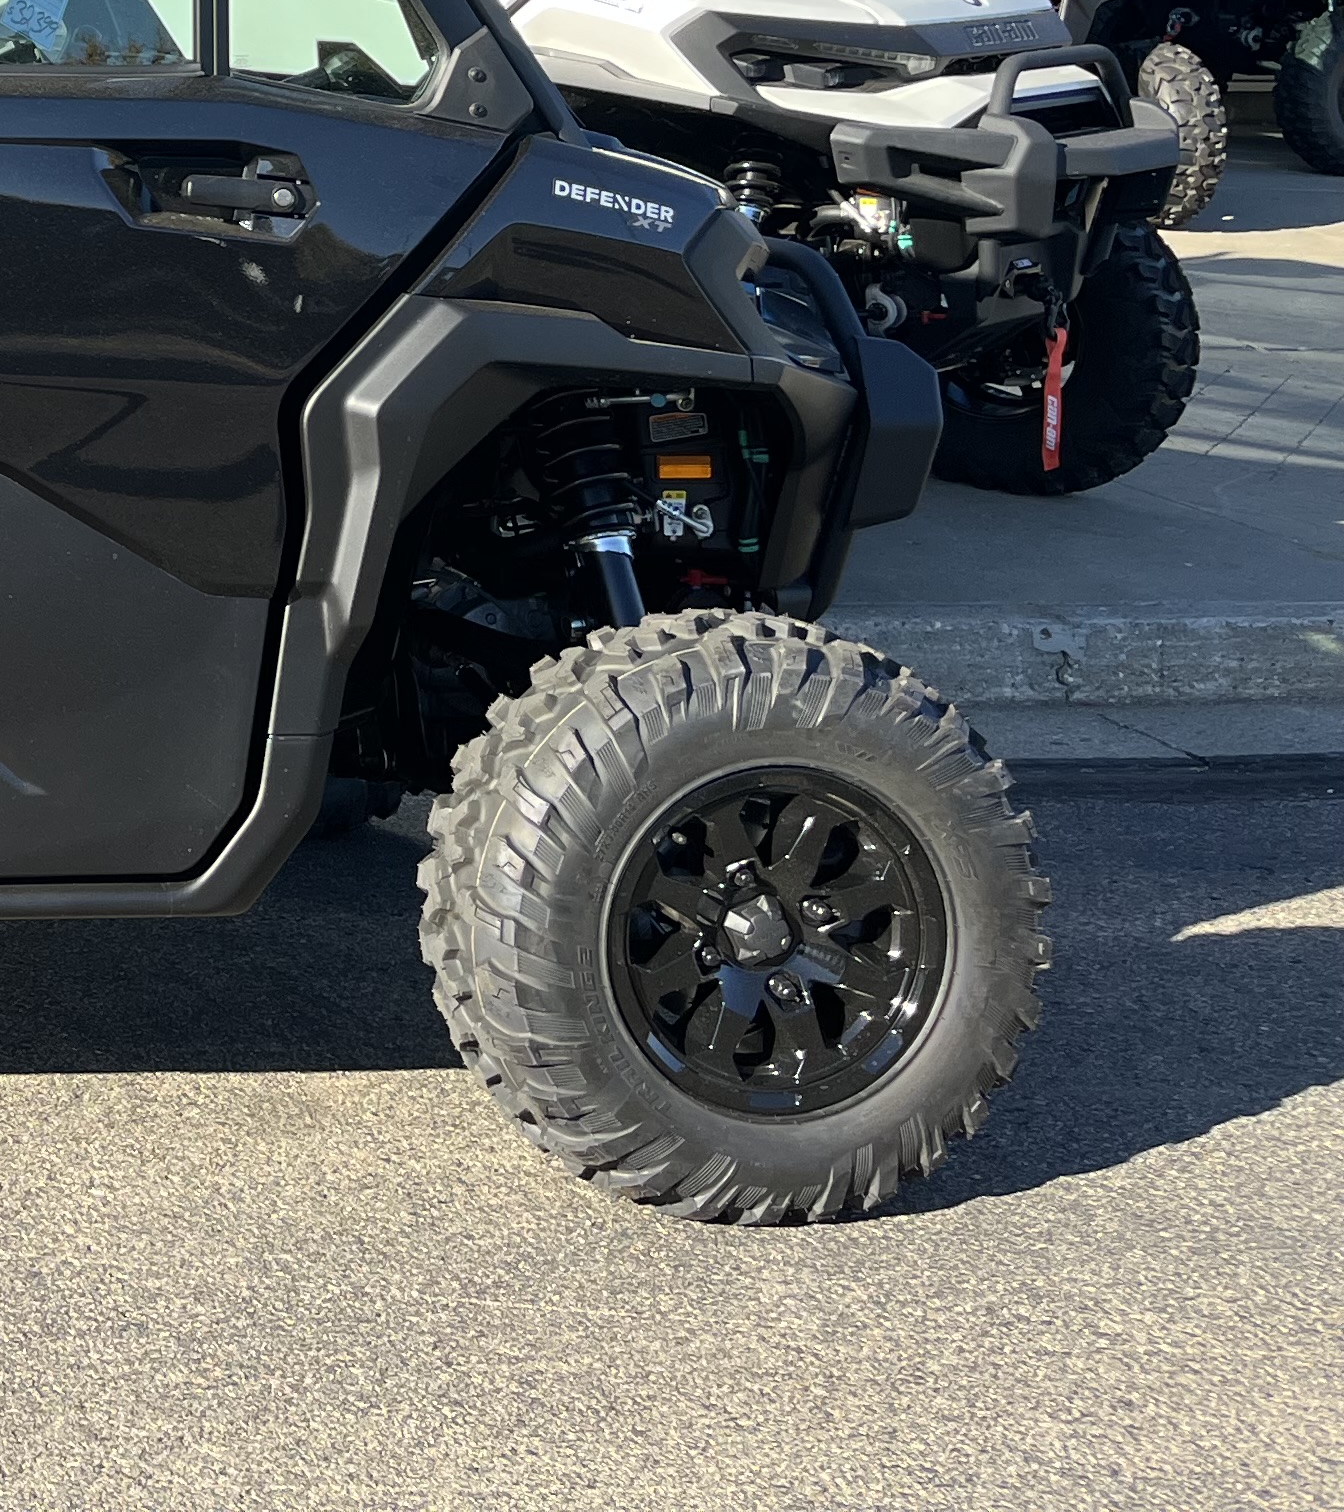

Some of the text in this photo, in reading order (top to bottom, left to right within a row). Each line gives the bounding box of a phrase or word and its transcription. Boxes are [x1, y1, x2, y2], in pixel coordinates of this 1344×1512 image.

[553, 179, 675, 223] DEFENDER
[631, 215, 672, 233] XT
[1045, 395, 1059, 451] can-am
